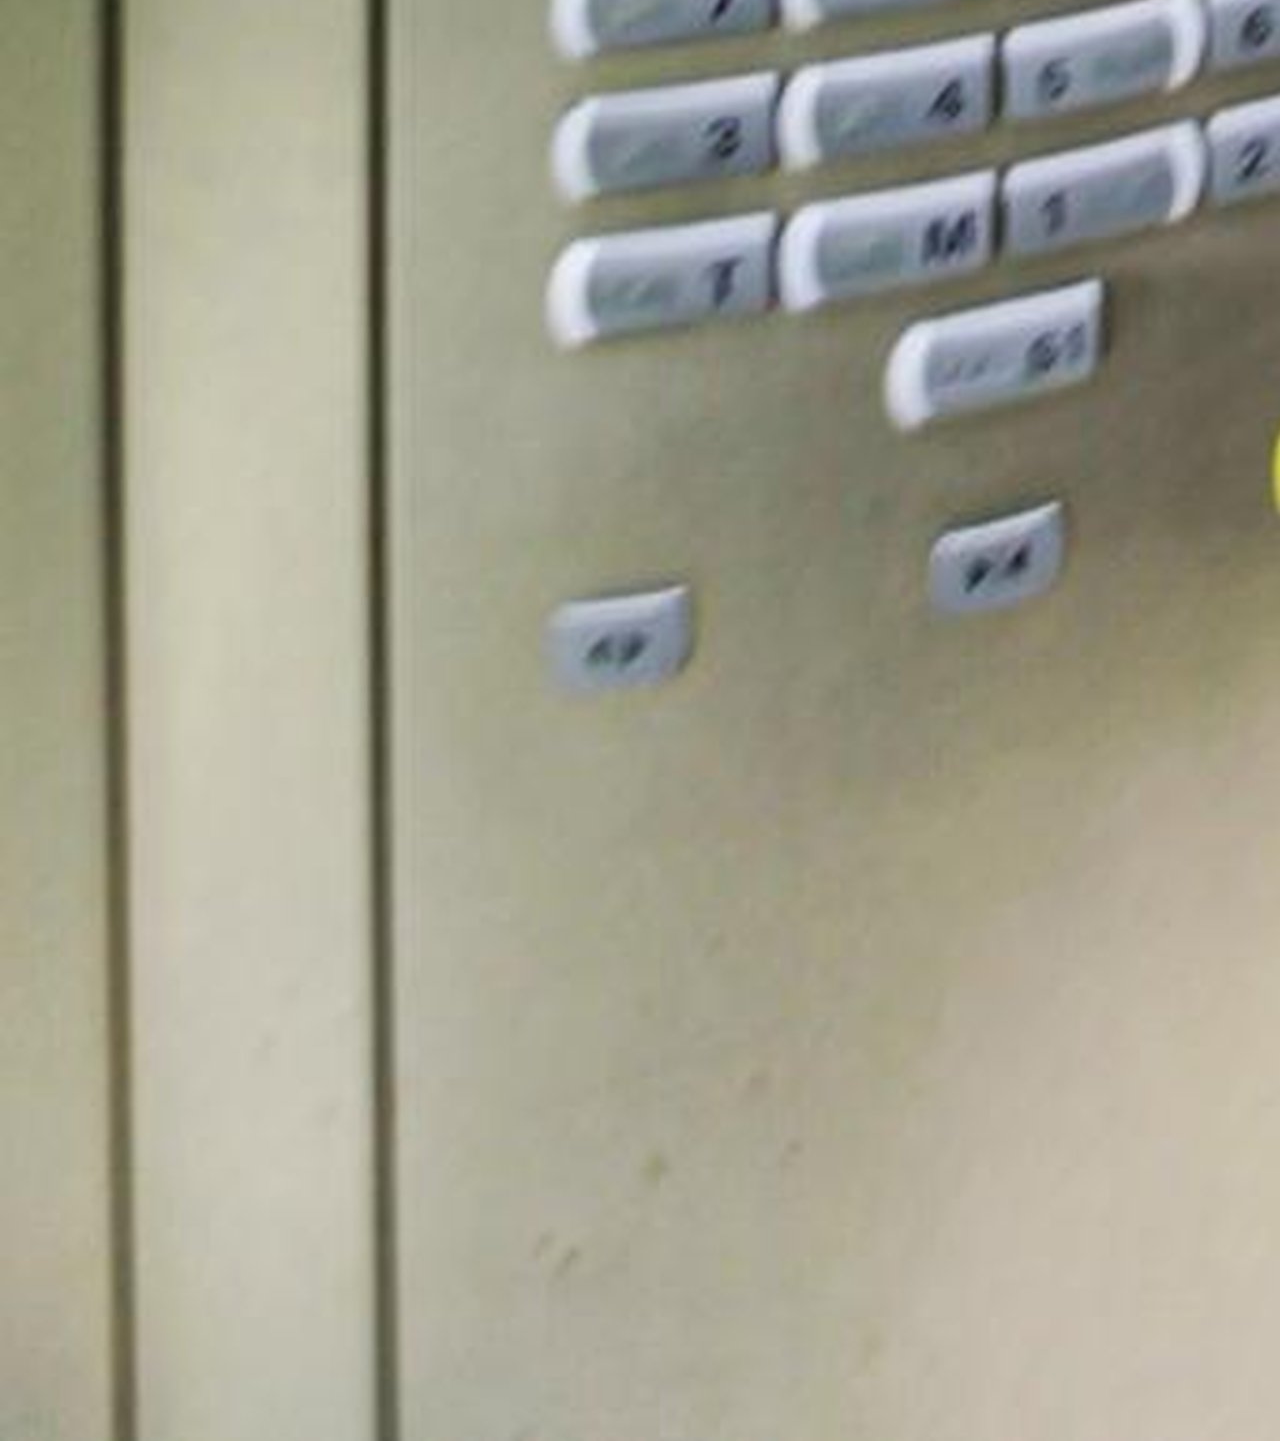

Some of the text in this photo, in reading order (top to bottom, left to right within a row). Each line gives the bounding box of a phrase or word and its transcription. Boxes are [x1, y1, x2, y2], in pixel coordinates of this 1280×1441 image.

[1241, 7, 1272, 51] 6
[926, 79, 965, 125] 4
[1037, 56, 1068, 103] 5
[705, 115, 742, 161] 3
[1239, 139, 1272, 184] 2
[1038, 187, 1065, 233] 1
[920, 213, 978, 267] M
[706, 257, 744, 307] T
